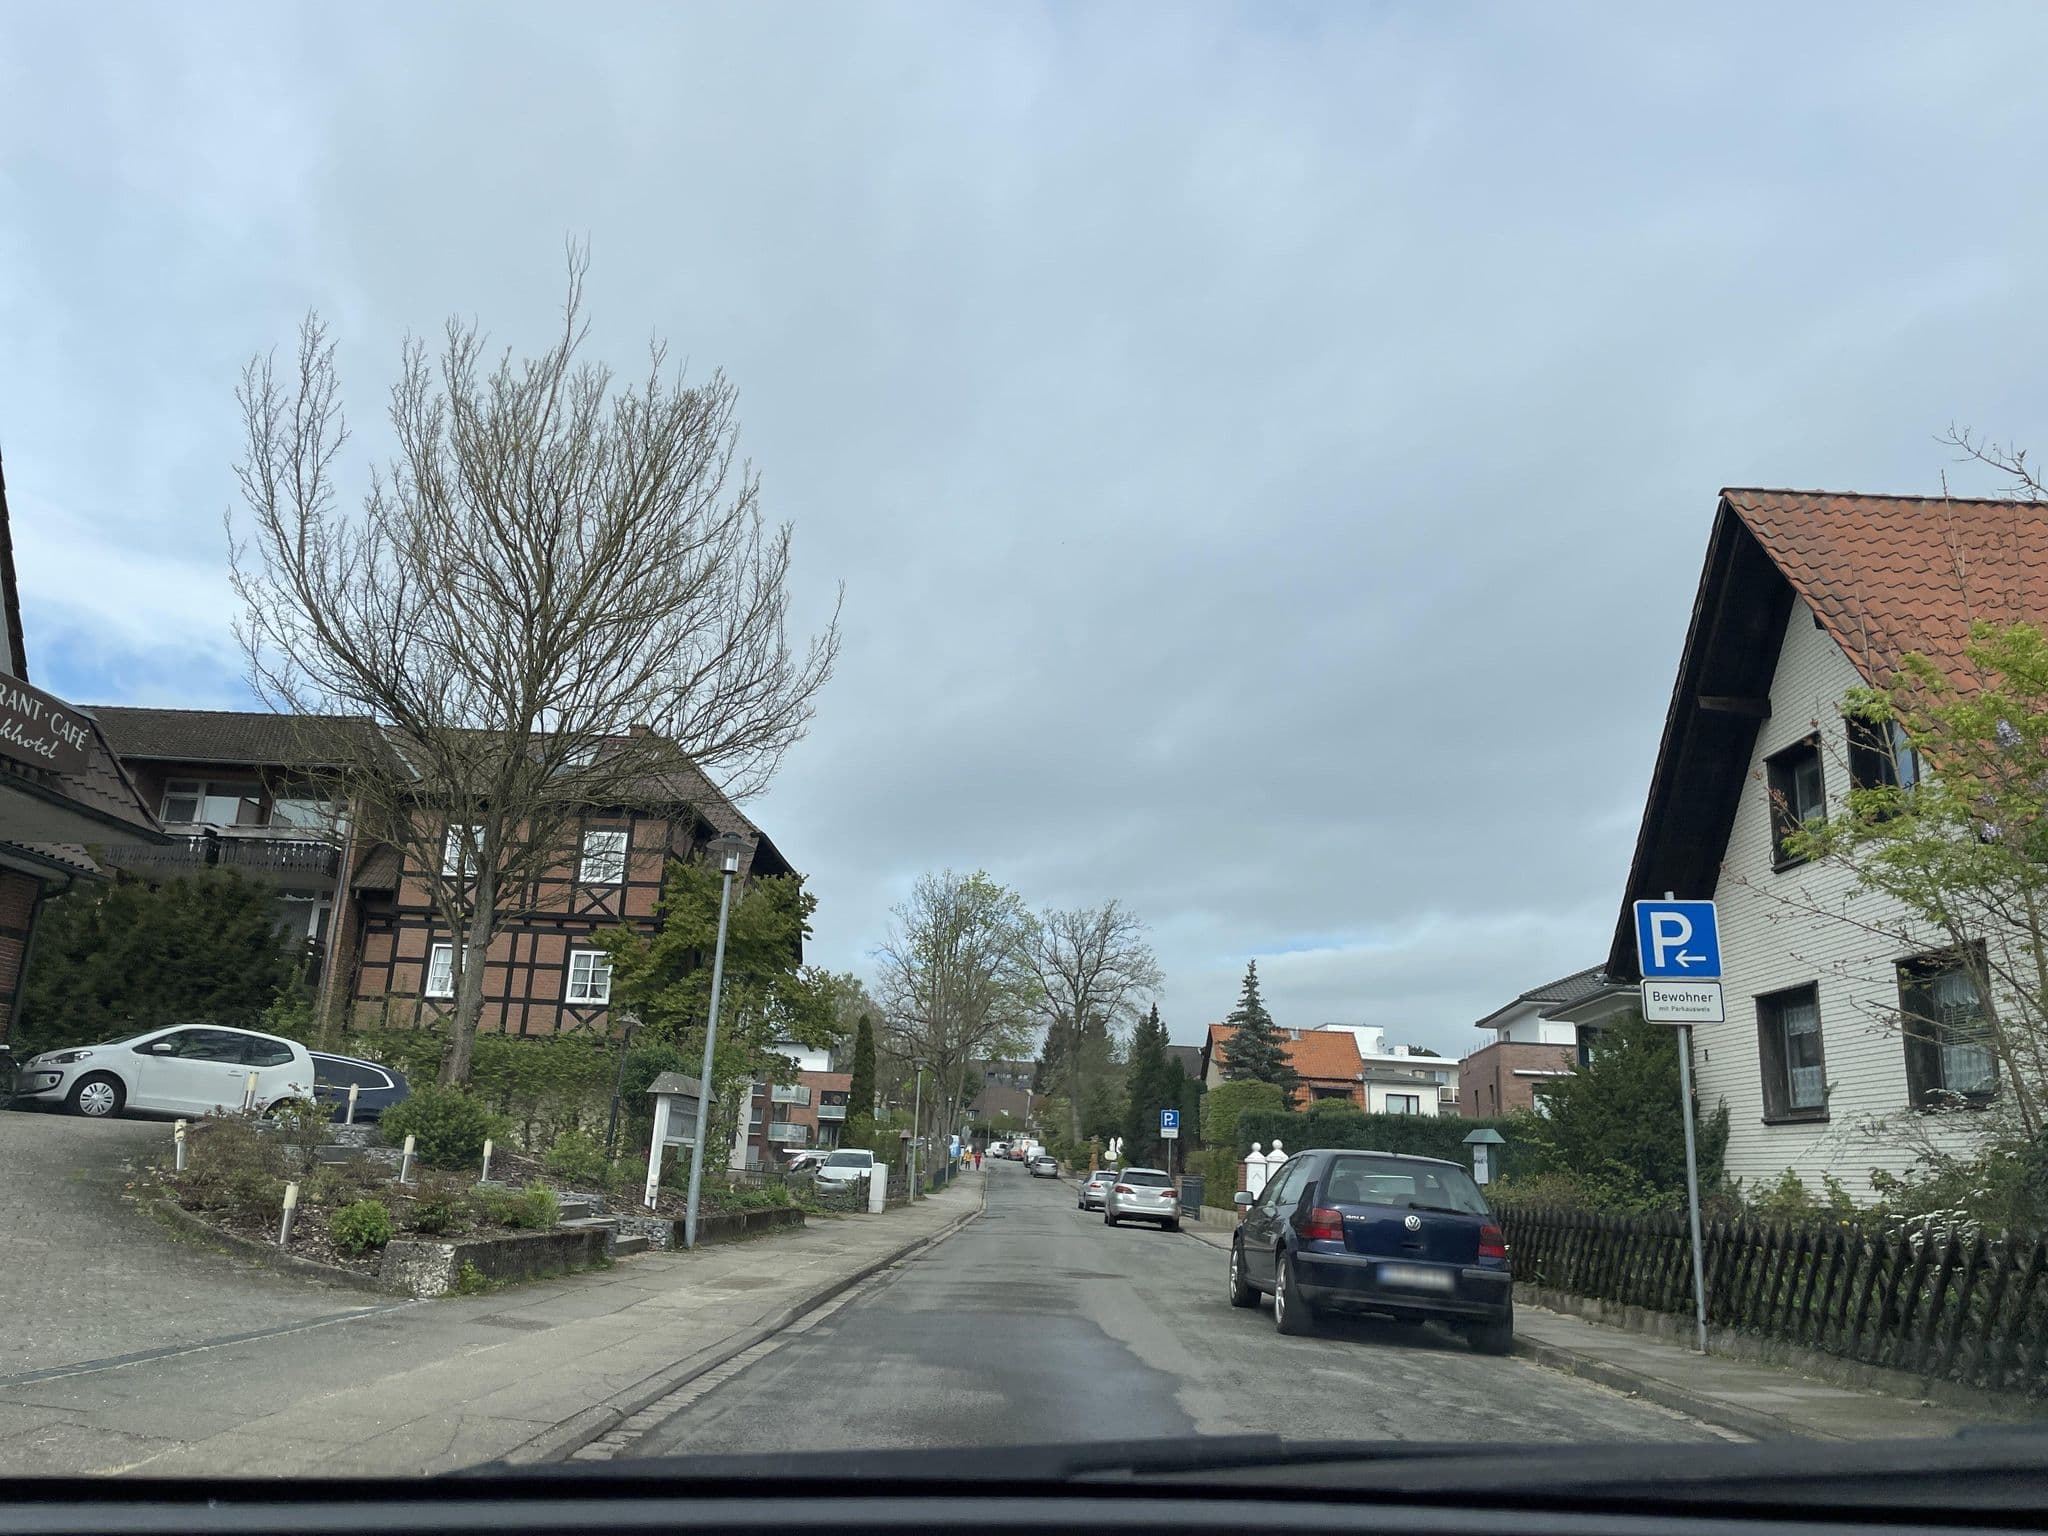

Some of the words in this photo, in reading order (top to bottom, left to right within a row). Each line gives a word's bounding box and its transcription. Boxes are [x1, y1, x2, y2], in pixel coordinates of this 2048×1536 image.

[50, 712, 89, 751] CAFÉ
[1650, 911, 1693, 968] P
[1652, 991, 1714, 1003] Bewohner
[1164, 1112, 1174, 1126] P
